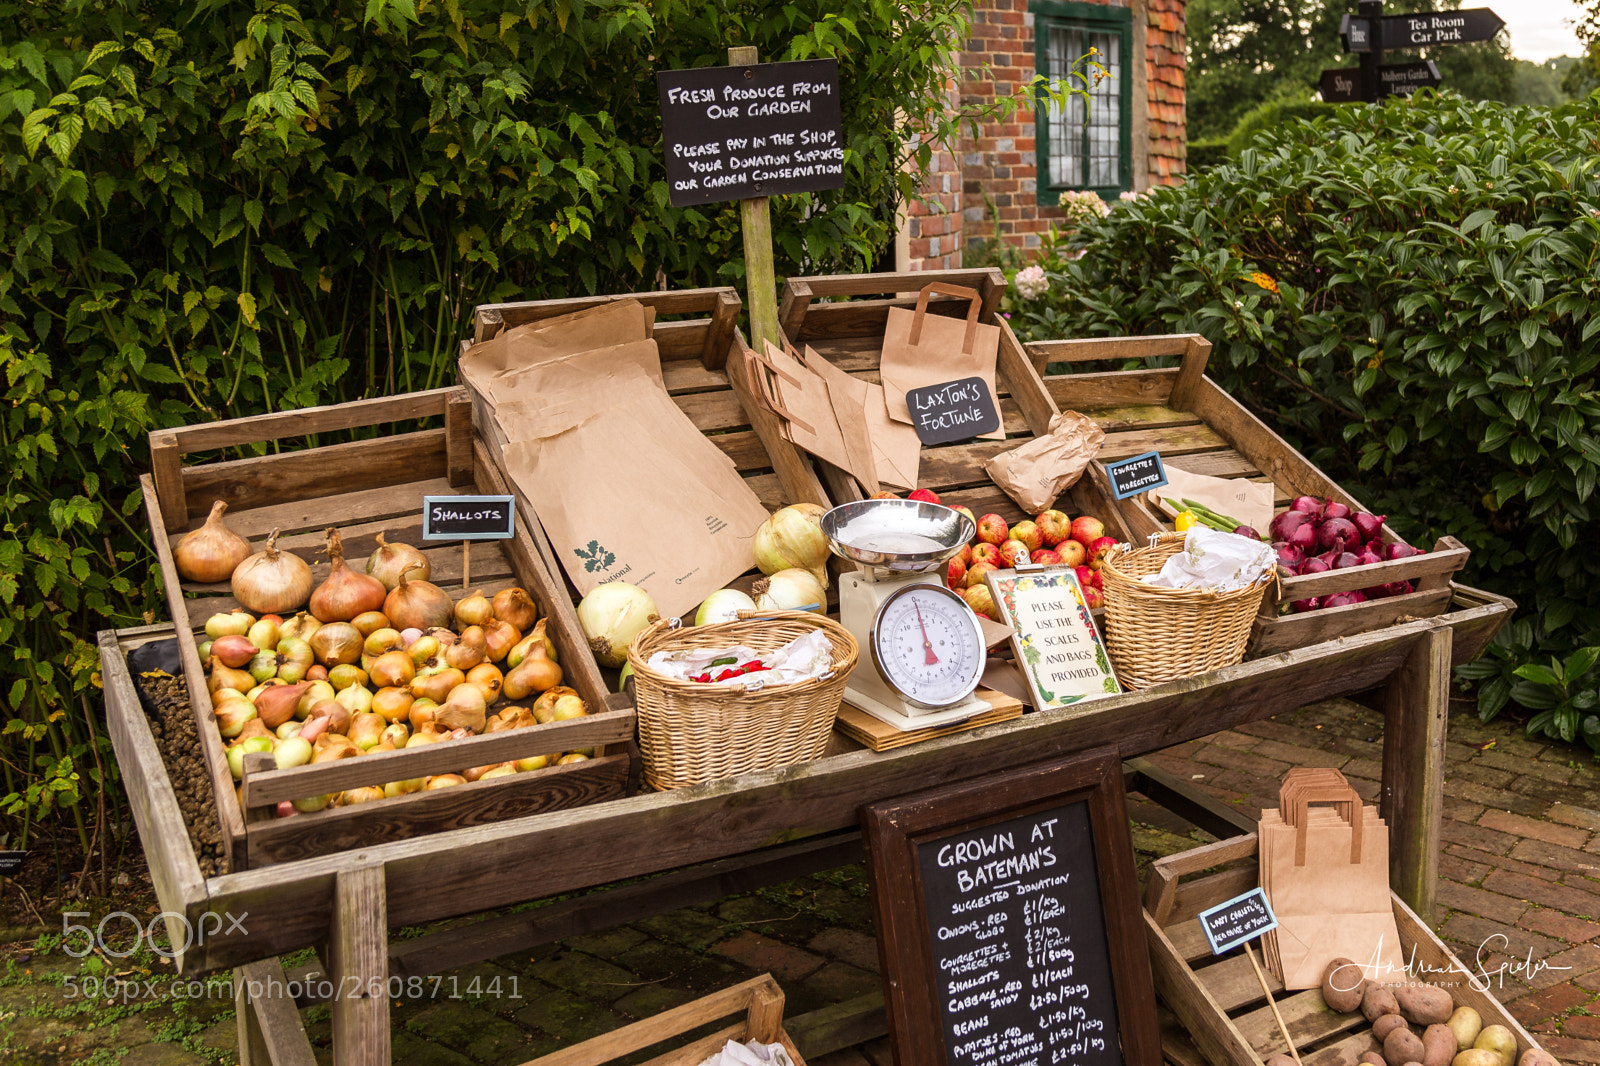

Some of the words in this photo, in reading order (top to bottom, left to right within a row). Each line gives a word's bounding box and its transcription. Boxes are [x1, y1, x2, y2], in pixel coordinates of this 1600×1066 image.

[1408, 18, 1428, 31] Tea
[1431, 16, 1465, 29] Room
[1410, 32, 1432, 43] Car
[1436, 28, 1462, 40] Park
[1334, 76, 1353, 95] Shop
[1381, 70, 1407, 83] Mulberry
[1407, 68, 1429, 80] Garden
[667, 87, 716, 104] FRESH
[723, 85, 786, 102] PRODUCE
[792, 81, 831, 96] FROM
[706, 105, 740, 119] OUR
[747, 100, 811, 117] GARDEN
[673, 142, 721, 158] PLEASE
[726, 137, 748, 152] PAY
[753, 136, 766, 149] IN
[769, 133, 795, 147] THE
[799, 129, 837, 147] SHOP,
[688, 159, 723, 173] YOUR
[729, 153, 790, 170] DONATION
[793, 147, 845, 163] SUPPORTS
[674, 178, 699, 191] OUR
[703, 172, 748, 188] GARDEN
[752, 164, 842, 182] CONSERVATION
[915, 382, 981, 410] LAXTON'S
[920, 405, 984, 431] FORTUNE
[1113, 459, 1153, 476] COURGETTES
[432, 507, 502, 522] SHALLOTS
[598, 563, 633, 585] National
[1031, 600, 1066, 613] PLEASE
[1035, 618, 1055, 630] USE
[1055, 617, 1074, 628] THE
[1043, 633, 1080, 647] SCALES
[1046, 653, 1066, 665] AND
[1066, 650, 1092, 662] BAGS
[1050, 667, 1099, 683] PROVIDED
[937, 832, 1015, 868] GROWN
[1030, 818, 1058, 843] AT
[957, 846, 1057, 893] BATEMAN'S
[951, 890, 1010, 915] SUGGESTED
[1016, 873, 1070, 896] DONATION
[937, 920, 980, 940] ONIONS
[987, 912, 1008, 927] RED
[975, 926, 1005, 941] GLOBO
[1209, 915, 1228, 929] LADY
[1213, 932, 1227, 943] RED
[1226, 925, 1244, 937] DUKE
[1244, 922, 1252, 930] OF
[1250, 915, 1269, 928] YORK
[940, 943, 998, 969] COURGETTES
[951, 950, 1011, 976] MOREGETTES
[948, 970, 1000, 995] SHALLOTS
[948, 989, 997, 1013] CABBAGE
[990, 993, 1019, 1010] SAVOY
[953, 1015, 990, 1037] BEANS
[954, 1033, 998, 1058] POTATOES
[972, 1045, 996, 1061] DUKE
[998, 1040, 1009, 1052] OF
[1010, 1032, 1035, 1048] YORK
[999, 1041, 1044, 1065] TOMATOES
